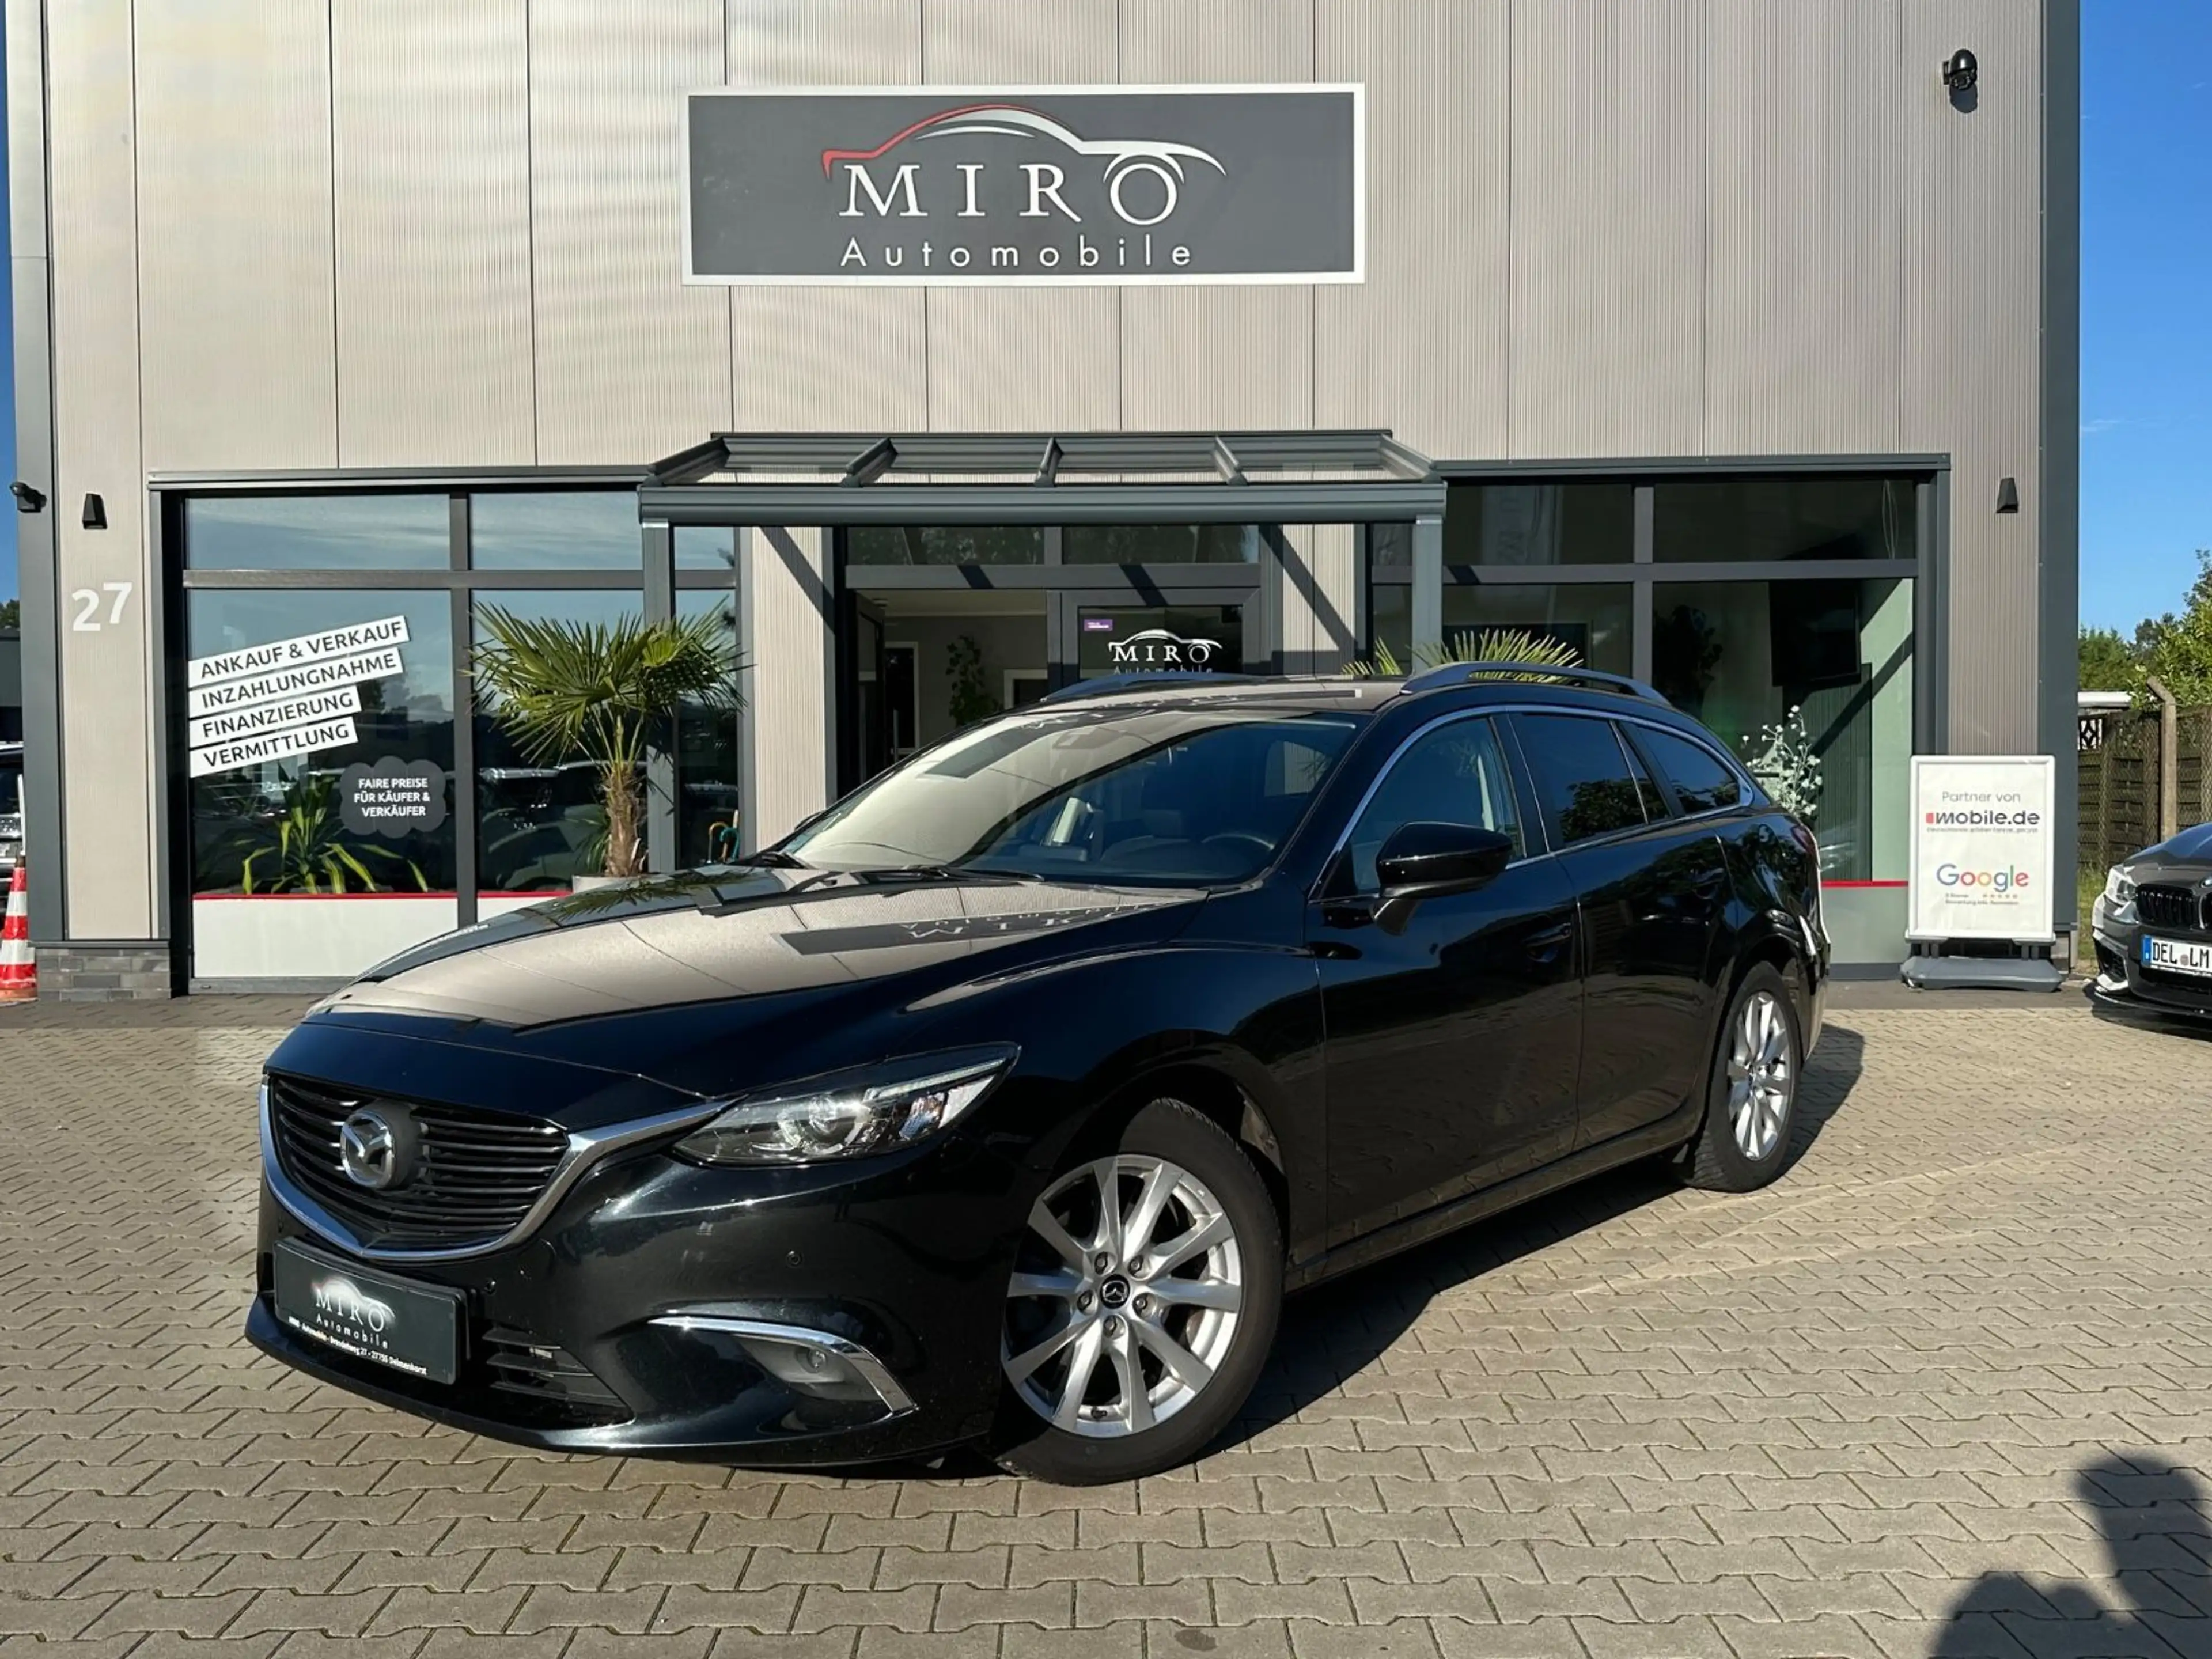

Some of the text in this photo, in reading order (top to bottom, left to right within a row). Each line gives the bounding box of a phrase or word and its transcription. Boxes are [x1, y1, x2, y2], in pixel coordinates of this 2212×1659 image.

[838, 162, 1177, 225] MIRO
[840, 234, 1191, 267] Automobile
[72, 582, 132, 631] 27
[201, 621, 402, 679] ANKAUF & VERKAUF
[1112, 645, 1209, 664] MIRO
[201, 653, 397, 709] INZAHLUNGNAHME
[203, 692, 353, 738] FINANZIERUNG
[204, 724, 350, 767] VERMITTLUNG
[354, 790, 431, 803] FÜR KÄUFER &
[359, 778, 428, 789] FAIRE PREISE
[1942, 791, 2021, 802] Partner von
[362, 804, 426, 817] VERKÄUFER
[1936, 810, 2040, 825] mobile.de
[1937, 863, 2029, 892] Google
[2153, 942, 2209, 968] DEL LM
[315, 1288, 384, 1332] MIRO
[316, 1313, 388, 1349] Automobile
